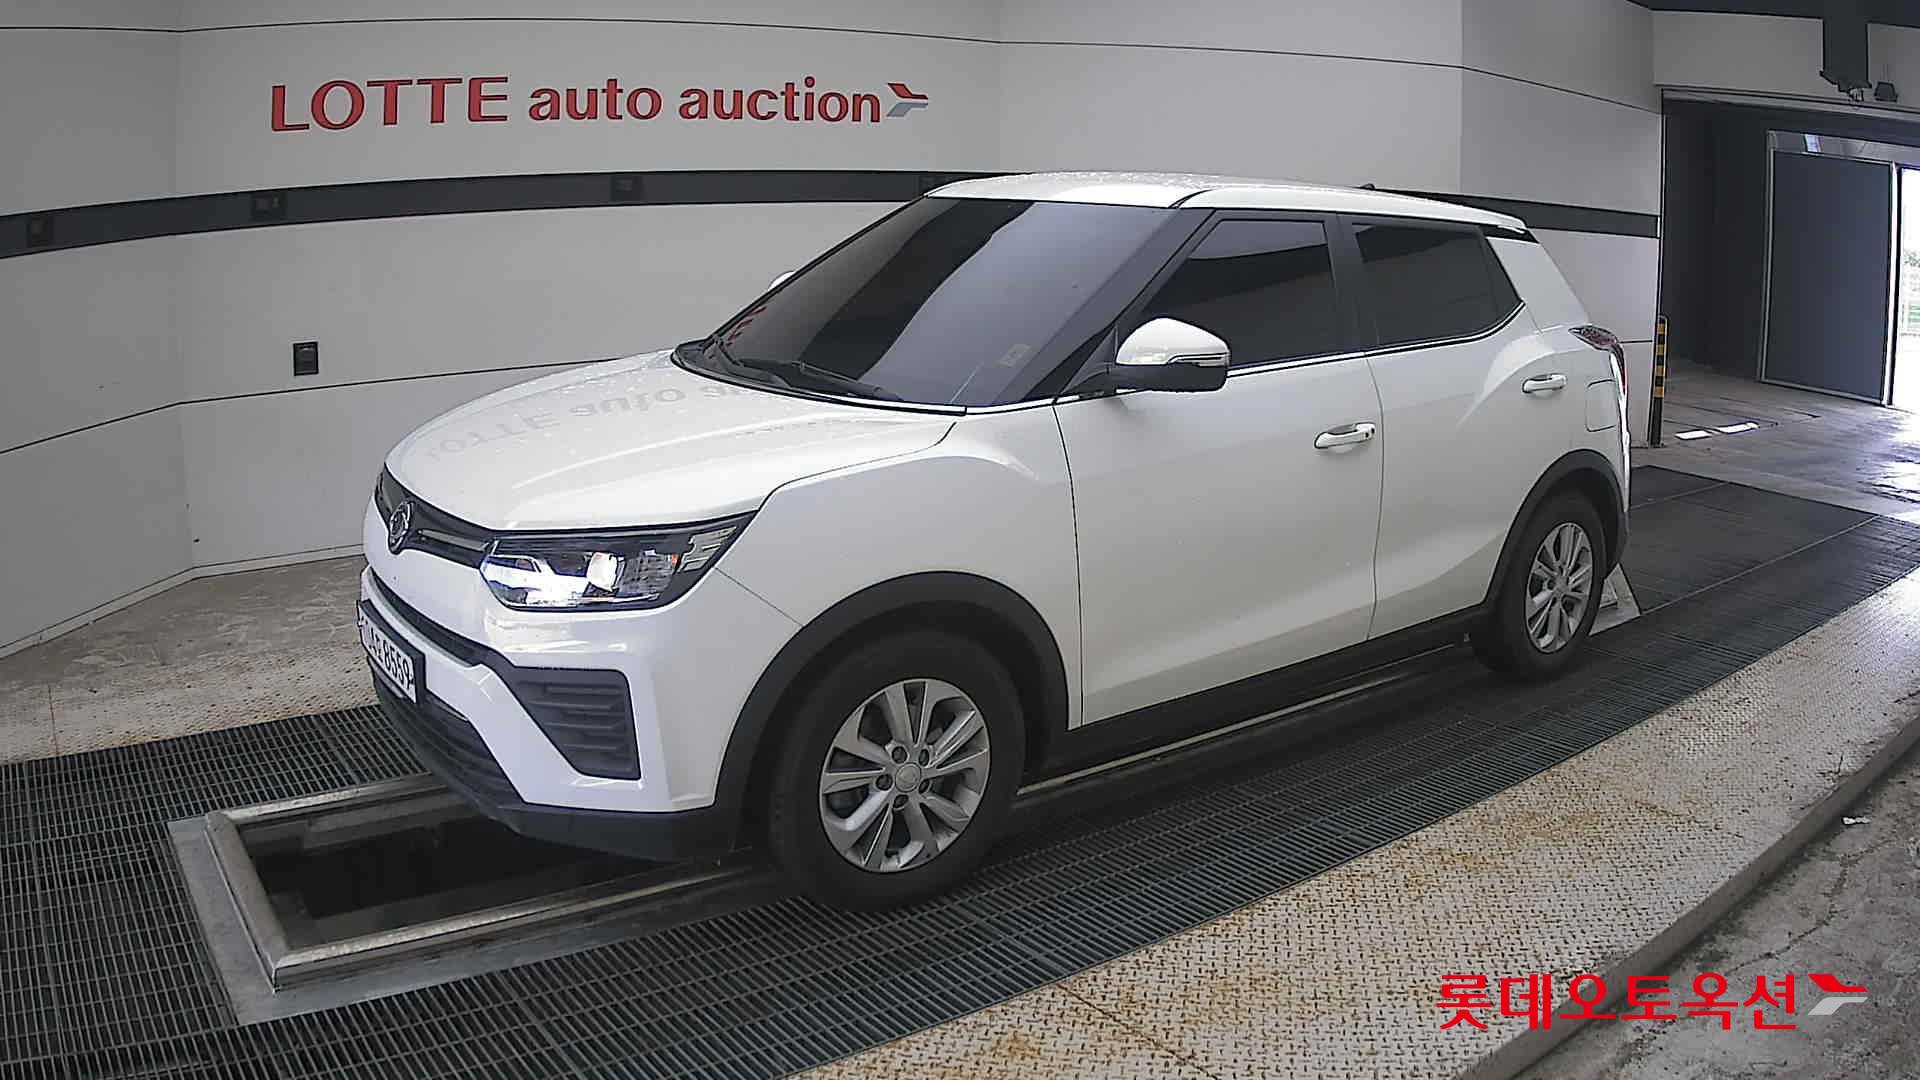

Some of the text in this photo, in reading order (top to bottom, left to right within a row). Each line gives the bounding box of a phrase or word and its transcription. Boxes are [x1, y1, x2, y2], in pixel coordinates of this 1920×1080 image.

[270, 75, 881, 132] LOTTE auto auction
